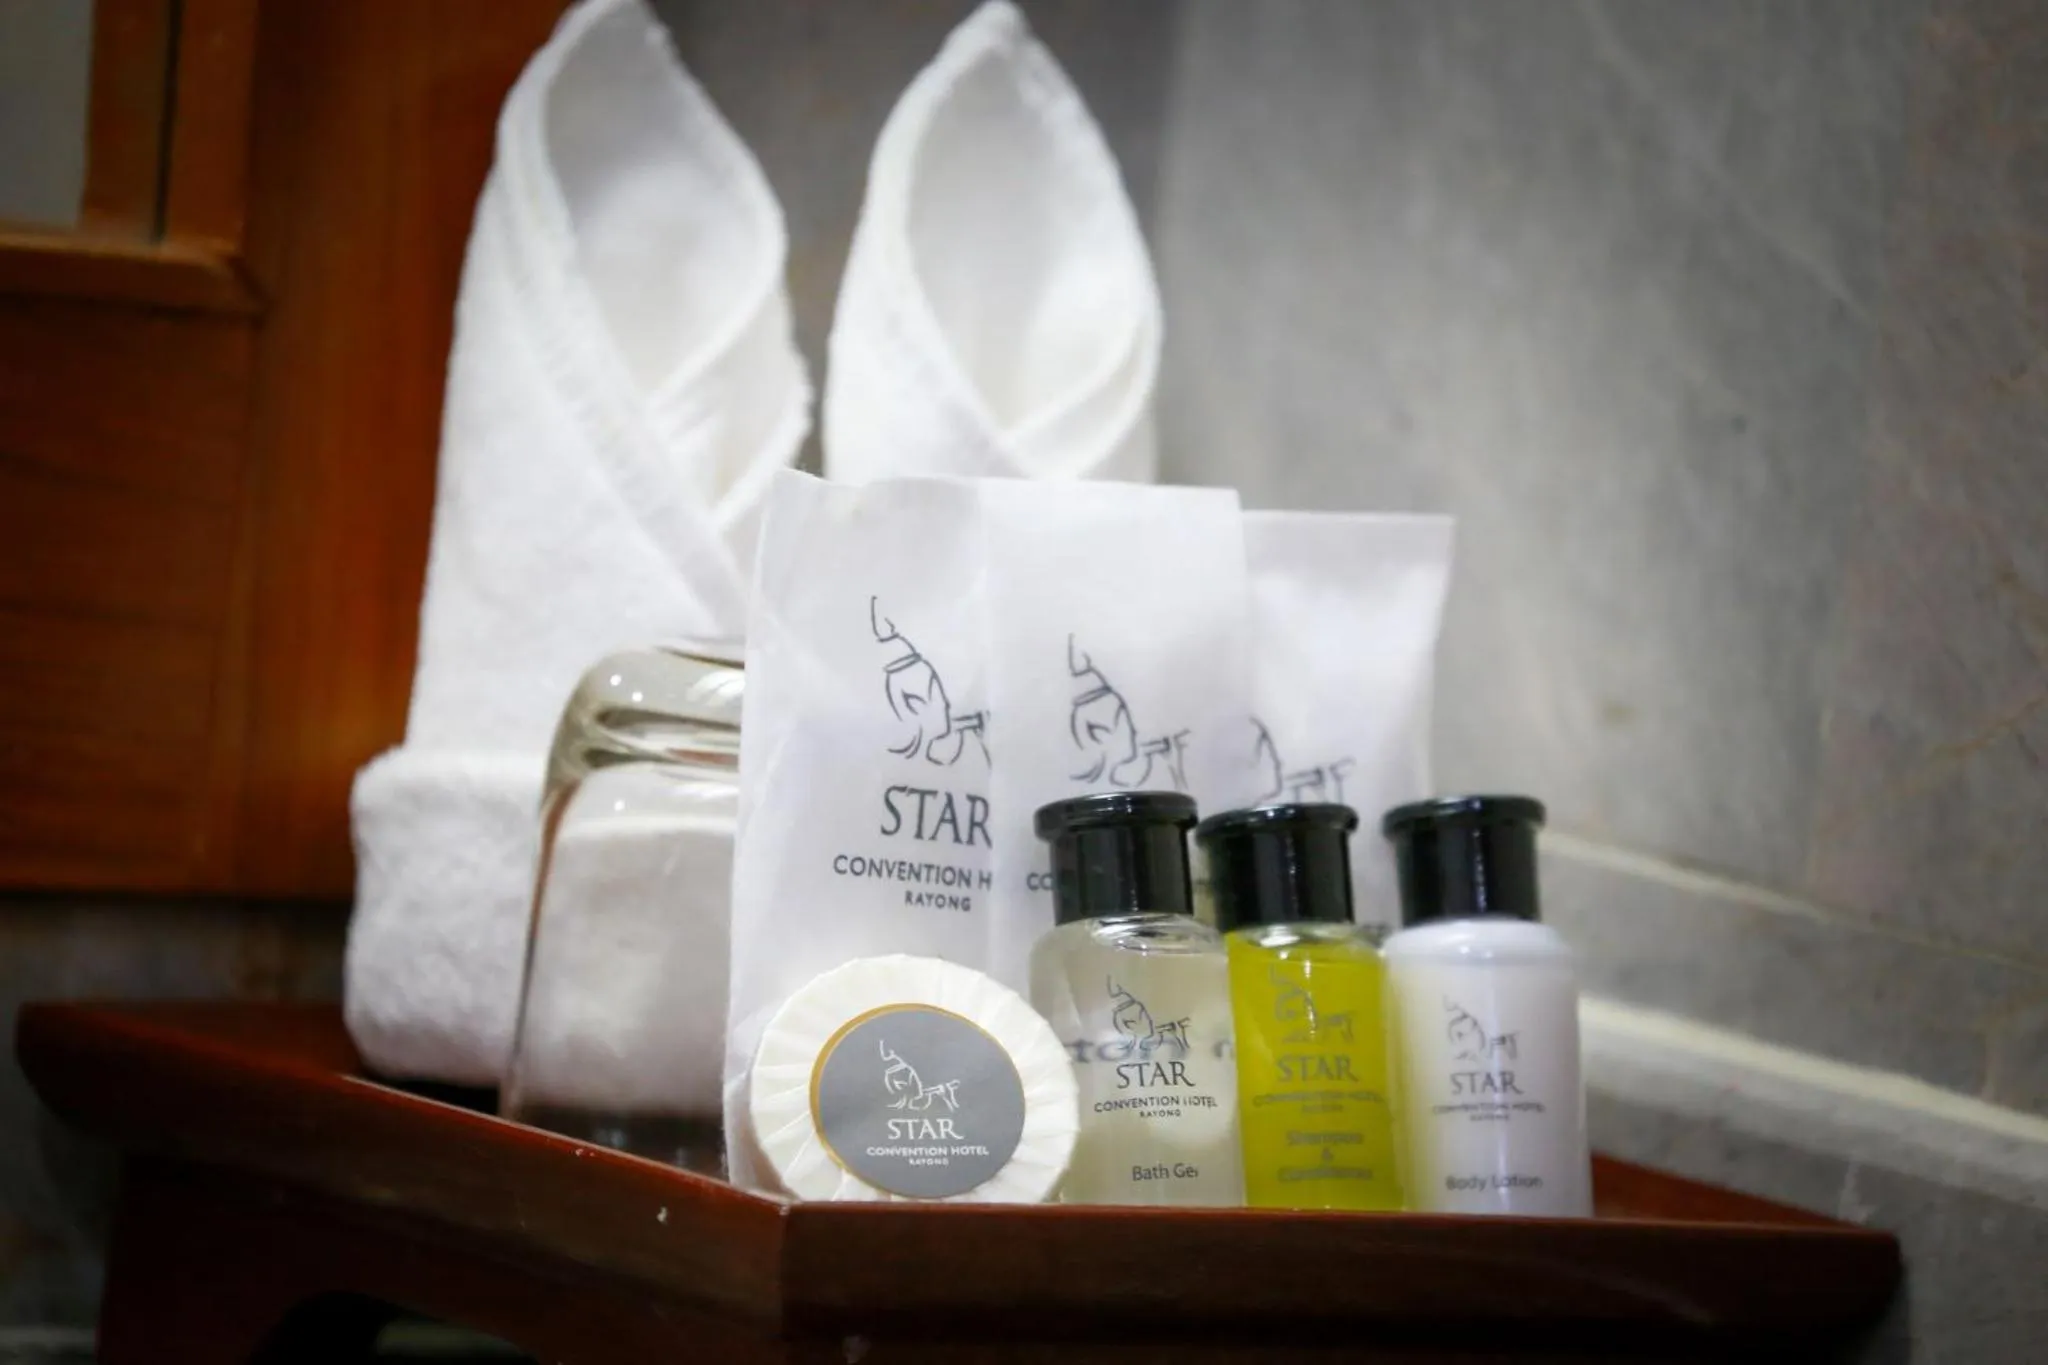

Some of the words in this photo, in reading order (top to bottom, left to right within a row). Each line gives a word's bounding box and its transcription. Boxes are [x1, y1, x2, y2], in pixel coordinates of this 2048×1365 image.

[880, 785, 993, 850] STAR
[833, 854, 972, 889] CONVENTION
[904, 890, 972, 912] RAYONG
[1115, 1060, 1196, 1089] STAR
[1276, 1055, 1360, 1082] STAR
[1451, 1071, 1525, 1095] STAR
[1094, 1096, 1180, 1113] CONVENTION
[886, 1118, 965, 1141] STAR
[866, 1146, 948, 1157] CONVENTION
[951, 1145, 990, 1156] HOTEL
[1131, 1163, 1170, 1182] Bath
[1445, 1175, 1488, 1192] Body
[1491, 1173, 1544, 1190] Lotion
